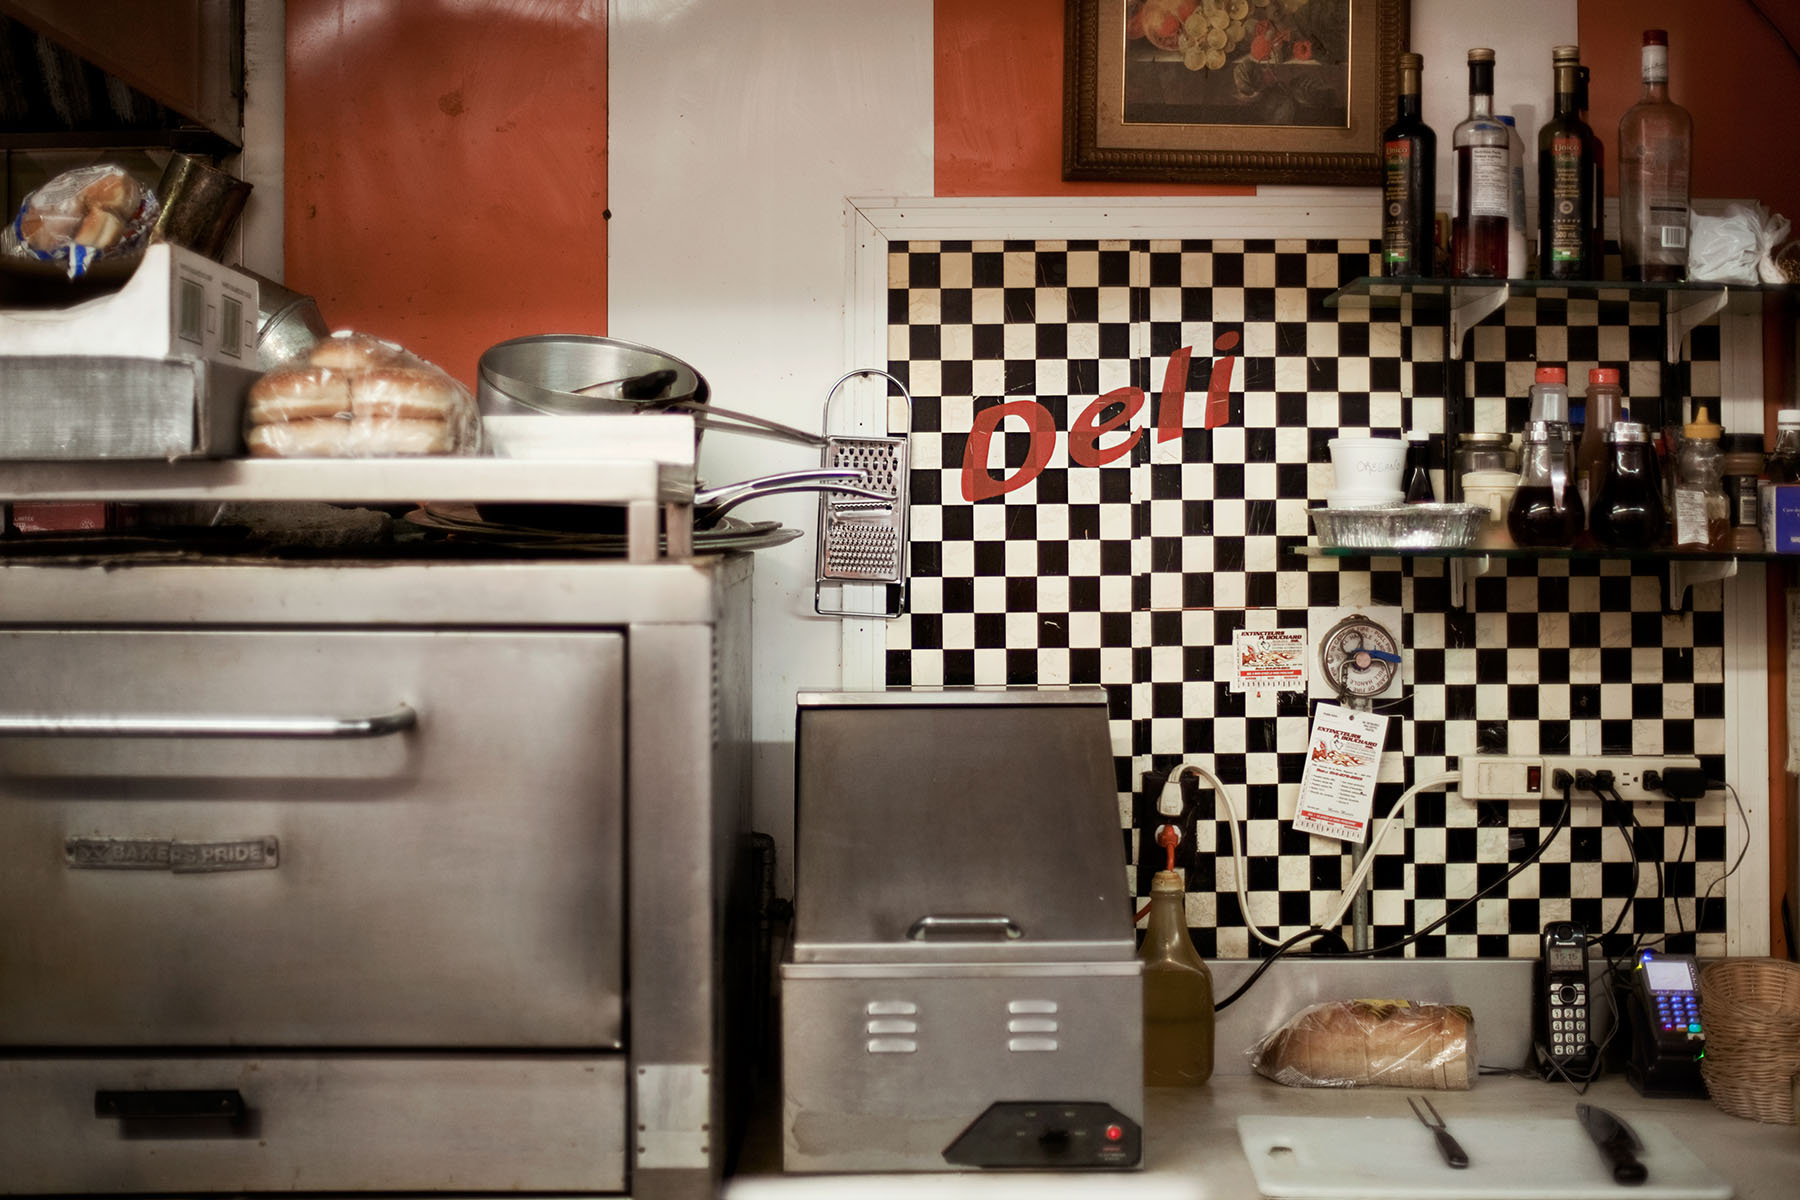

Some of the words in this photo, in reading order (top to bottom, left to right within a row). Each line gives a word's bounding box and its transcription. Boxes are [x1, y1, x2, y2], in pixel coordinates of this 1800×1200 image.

[1555, 143, 1580, 152] Unico
[961, 330, 1240, 502] Deli
[202, 845, 264, 863] PRIDE
